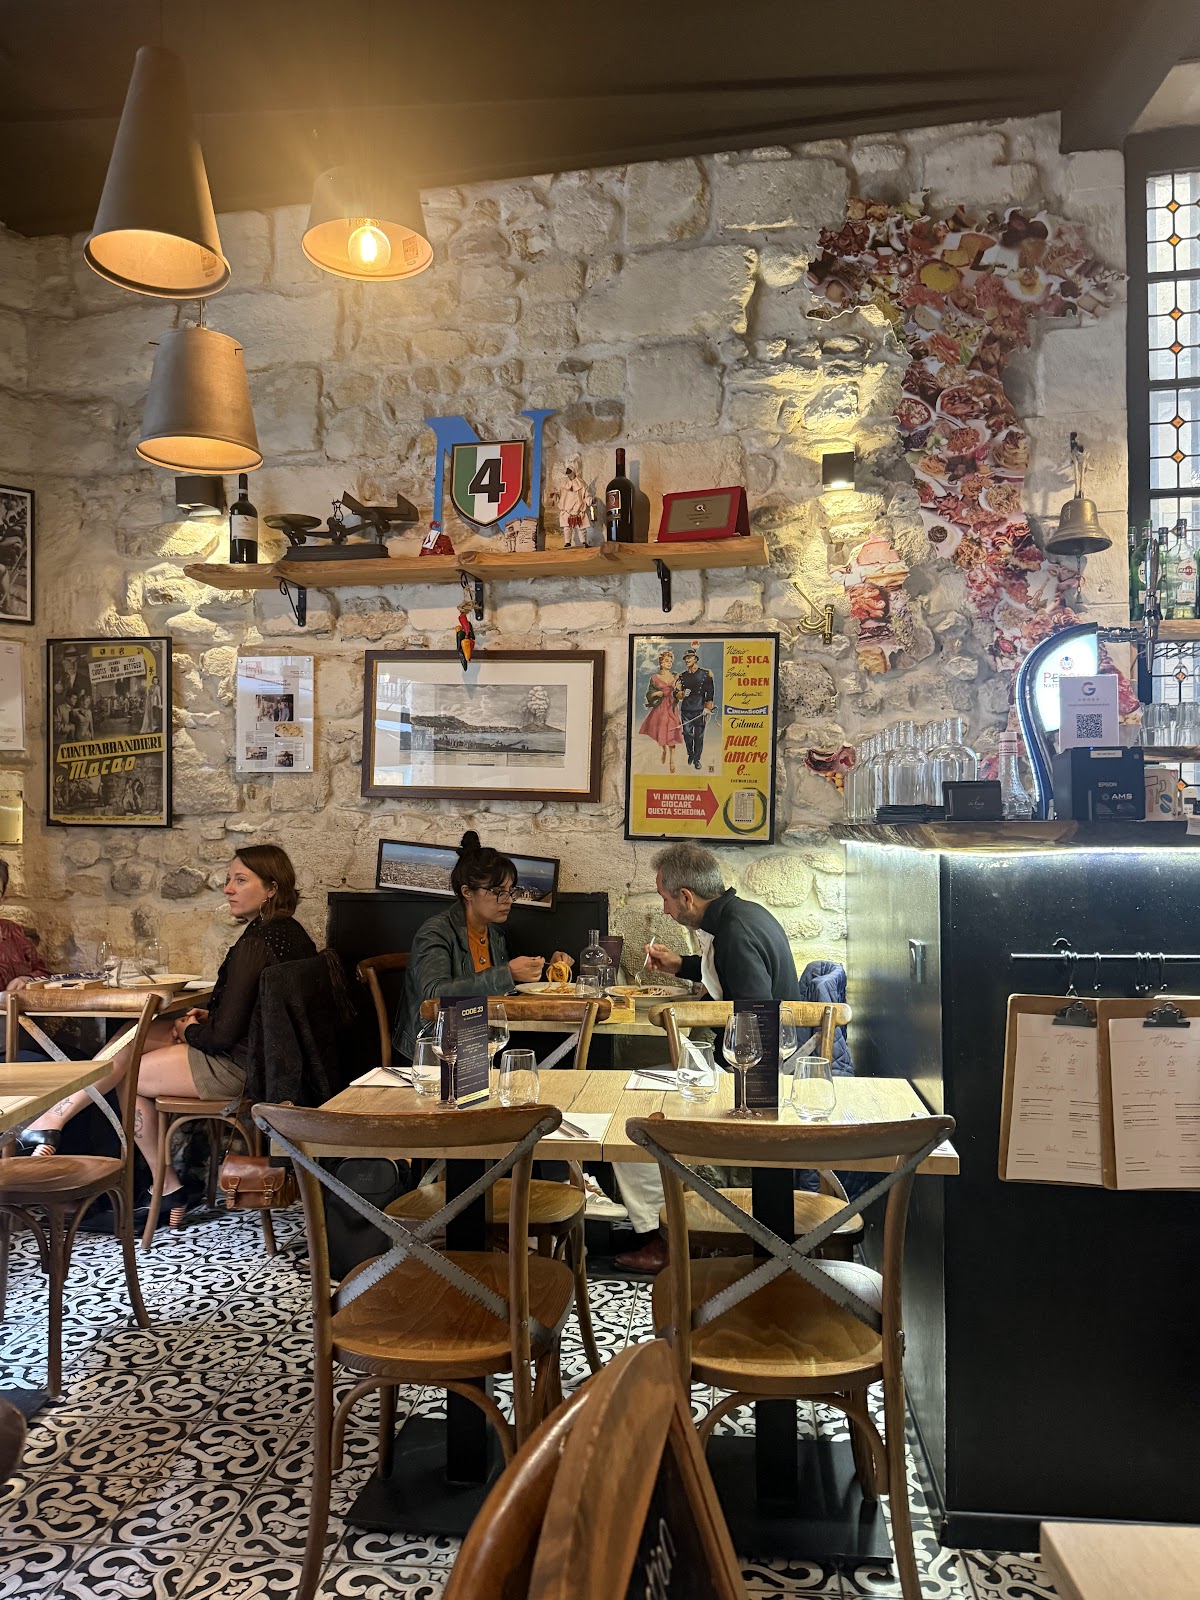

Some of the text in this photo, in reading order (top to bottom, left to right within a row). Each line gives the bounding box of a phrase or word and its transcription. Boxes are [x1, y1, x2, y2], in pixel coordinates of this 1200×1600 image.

[468, 457, 506, 504] 4
[731, 656, 769, 664] DE SICA
[737, 677, 769, 686] LOREN
[1081, 681, 1097, 696] G
[60, 736, 162, 759] CONTRABBANDIERI
[723, 735, 758, 751] pane,
[724, 751, 768, 764] amore
[56, 756, 136, 783] a Macao
[662, 793, 695, 801] INVITANO
[647, 807, 706, 816] QUESTA SCHEDINA
